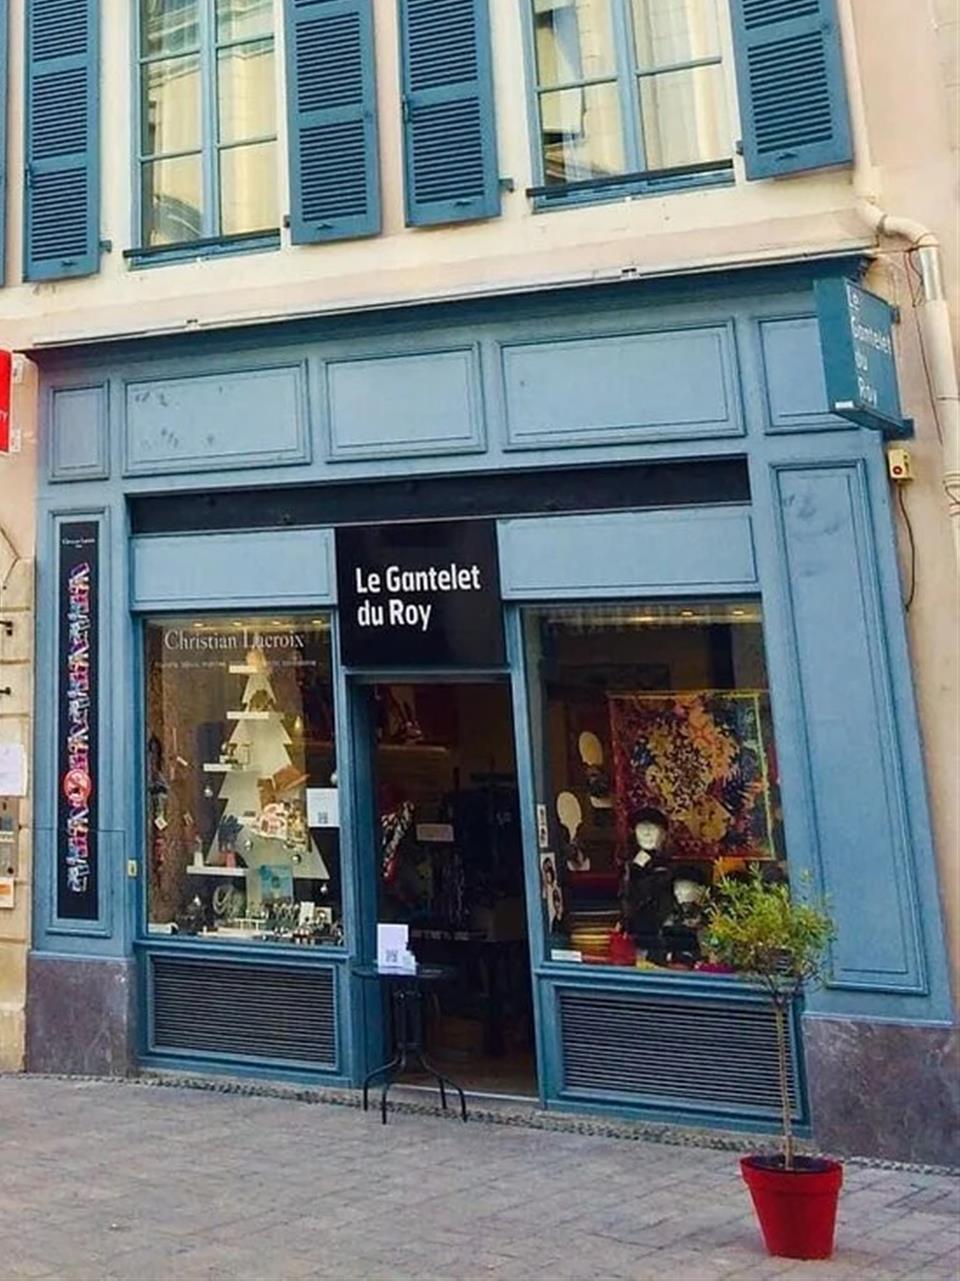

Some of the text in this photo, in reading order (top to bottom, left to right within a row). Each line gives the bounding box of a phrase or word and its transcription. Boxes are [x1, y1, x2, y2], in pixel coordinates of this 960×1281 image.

[356, 563, 481, 593] Le Gantelet
[357, 598, 432, 632] du Roy
[164, 629, 237, 651] Christian
